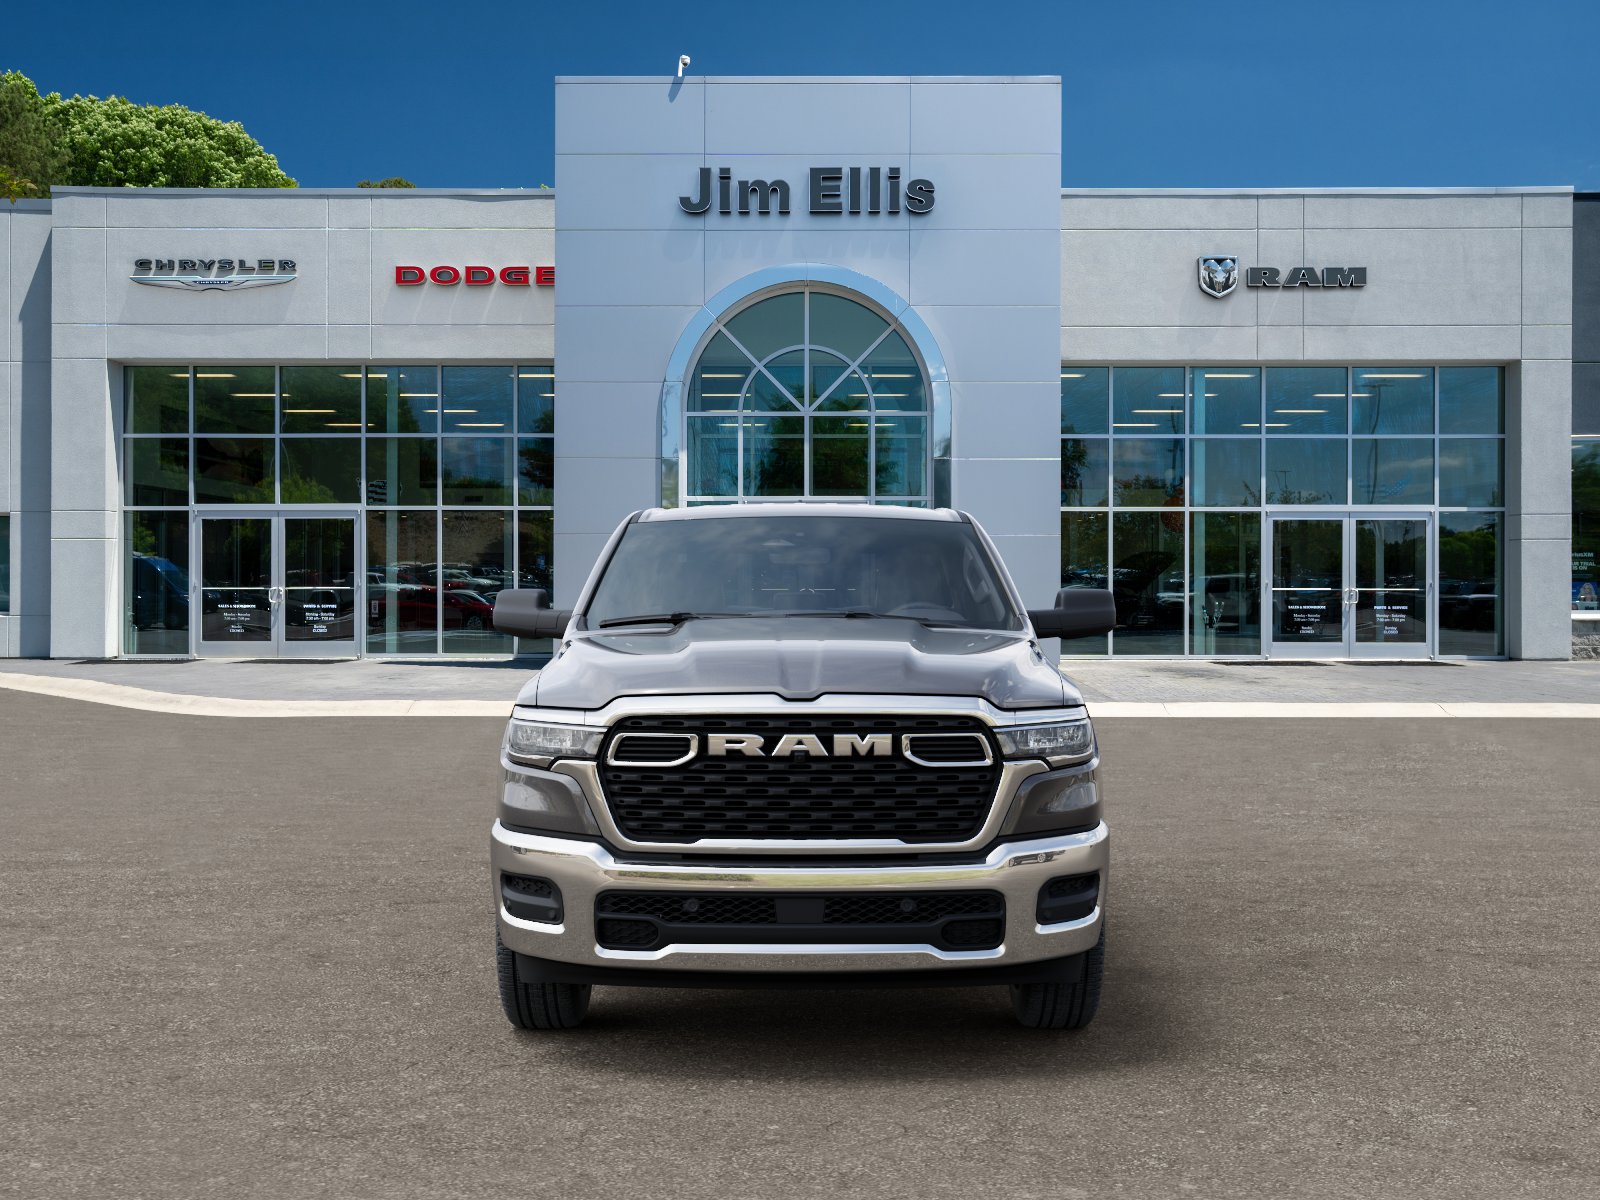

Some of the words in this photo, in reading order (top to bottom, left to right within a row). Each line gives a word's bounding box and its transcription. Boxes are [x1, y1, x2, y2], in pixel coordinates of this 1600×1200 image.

[679, 167, 790, 213] Jim
[809, 167, 936, 213] Ellis
[135, 258, 297, 270] CHRYSLER
[395, 265, 555, 286] DODGE
[1247, 266, 1367, 288] RAM
[707, 733, 893, 757] RAM
